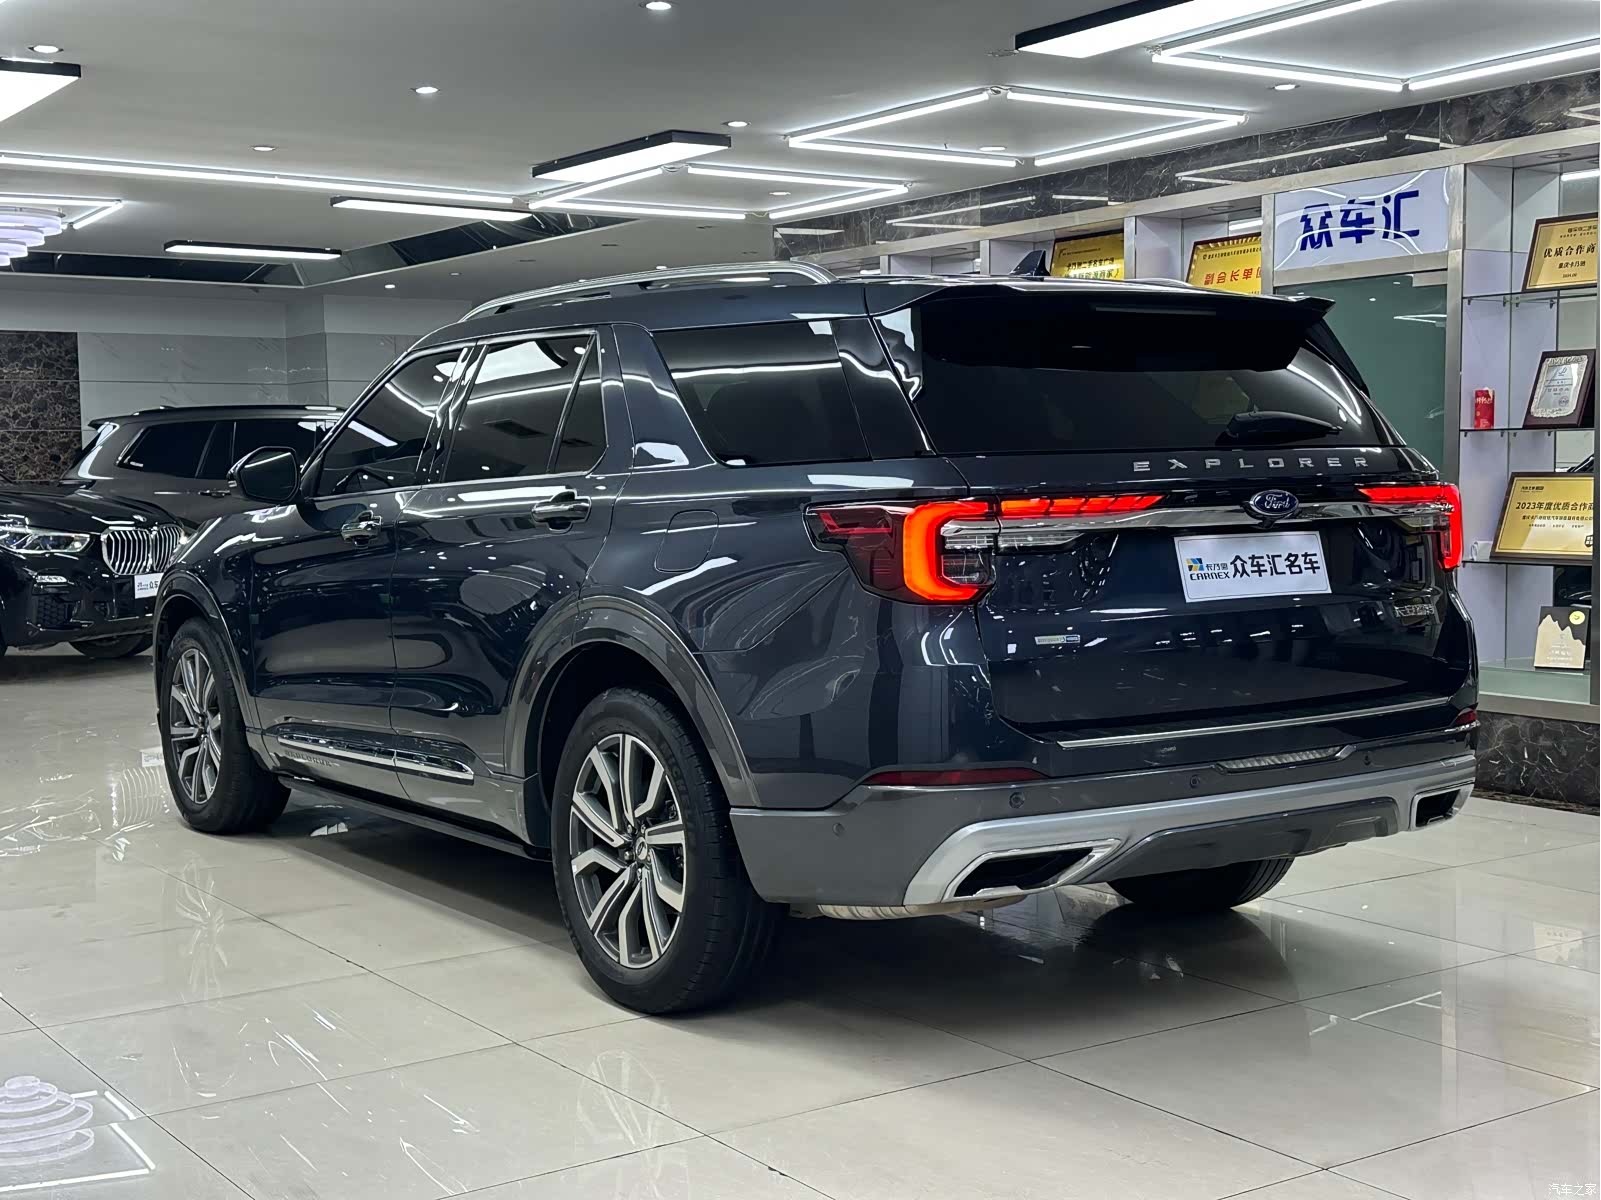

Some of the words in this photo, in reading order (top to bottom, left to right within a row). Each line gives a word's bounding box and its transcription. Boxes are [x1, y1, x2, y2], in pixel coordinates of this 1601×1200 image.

[1300, 190, 1420, 251] 众车汇
[1544, 243, 1597, 258] 优质合作商
[1133, 457, 1369, 472] EXPLORER
[1230, 551, 1321, 578] 众车汇名车
[1189, 571, 1231, 581] CARNEX
